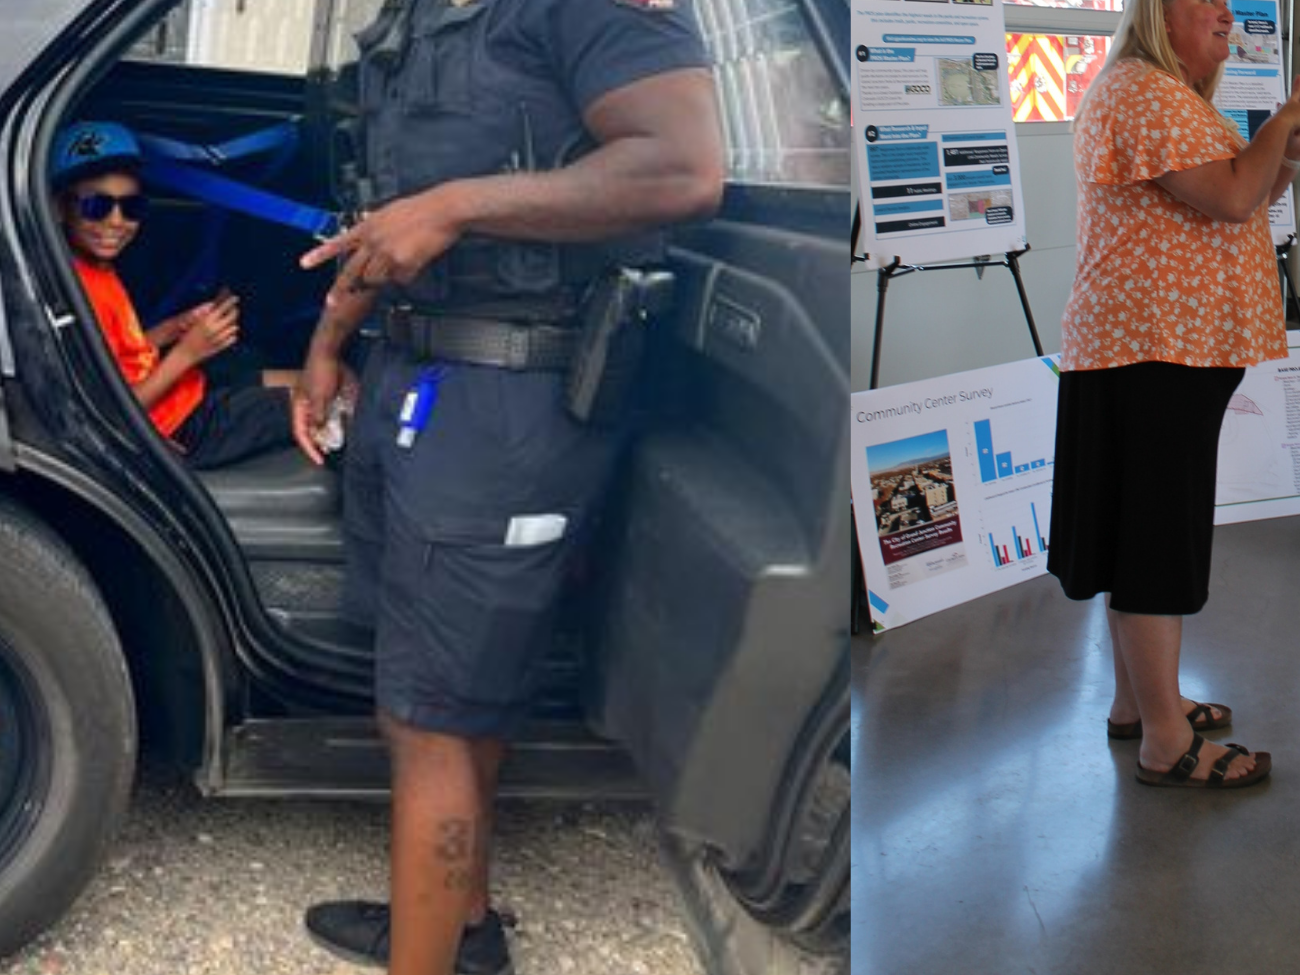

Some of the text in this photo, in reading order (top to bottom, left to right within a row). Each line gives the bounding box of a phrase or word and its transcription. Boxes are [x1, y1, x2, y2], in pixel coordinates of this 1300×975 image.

[856, 386, 993, 423] Community Center Survey
